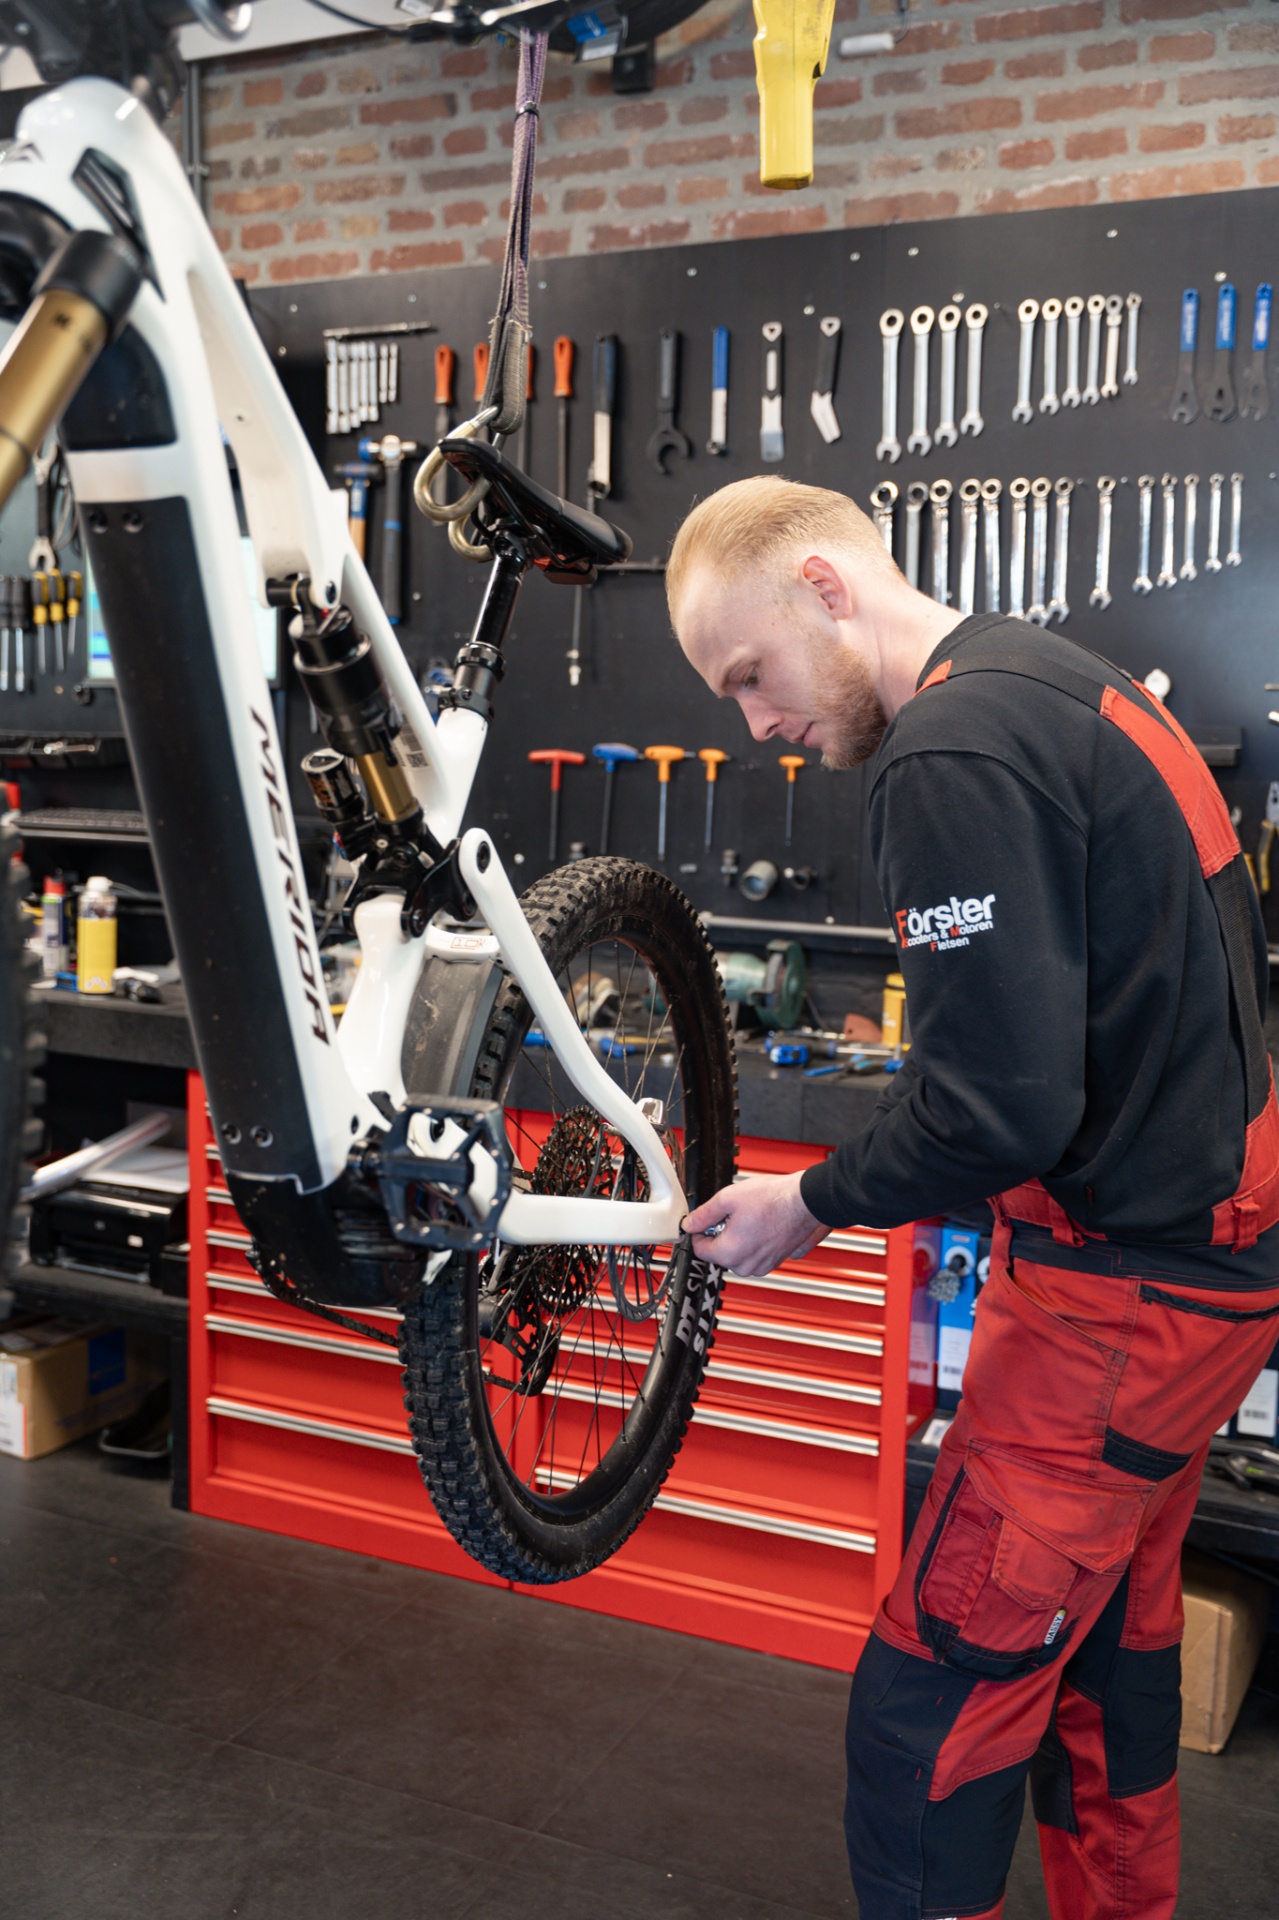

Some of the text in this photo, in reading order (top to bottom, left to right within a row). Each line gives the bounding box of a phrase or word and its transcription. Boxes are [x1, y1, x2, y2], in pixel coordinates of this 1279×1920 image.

[250, 704, 331, 1047] MERIDA
[895, 893, 996, 940] Förster
[950, 919, 994, 938] Motoren
[929, 936, 970, 952] Fietsen
[675, 1295, 698, 1347] DT
